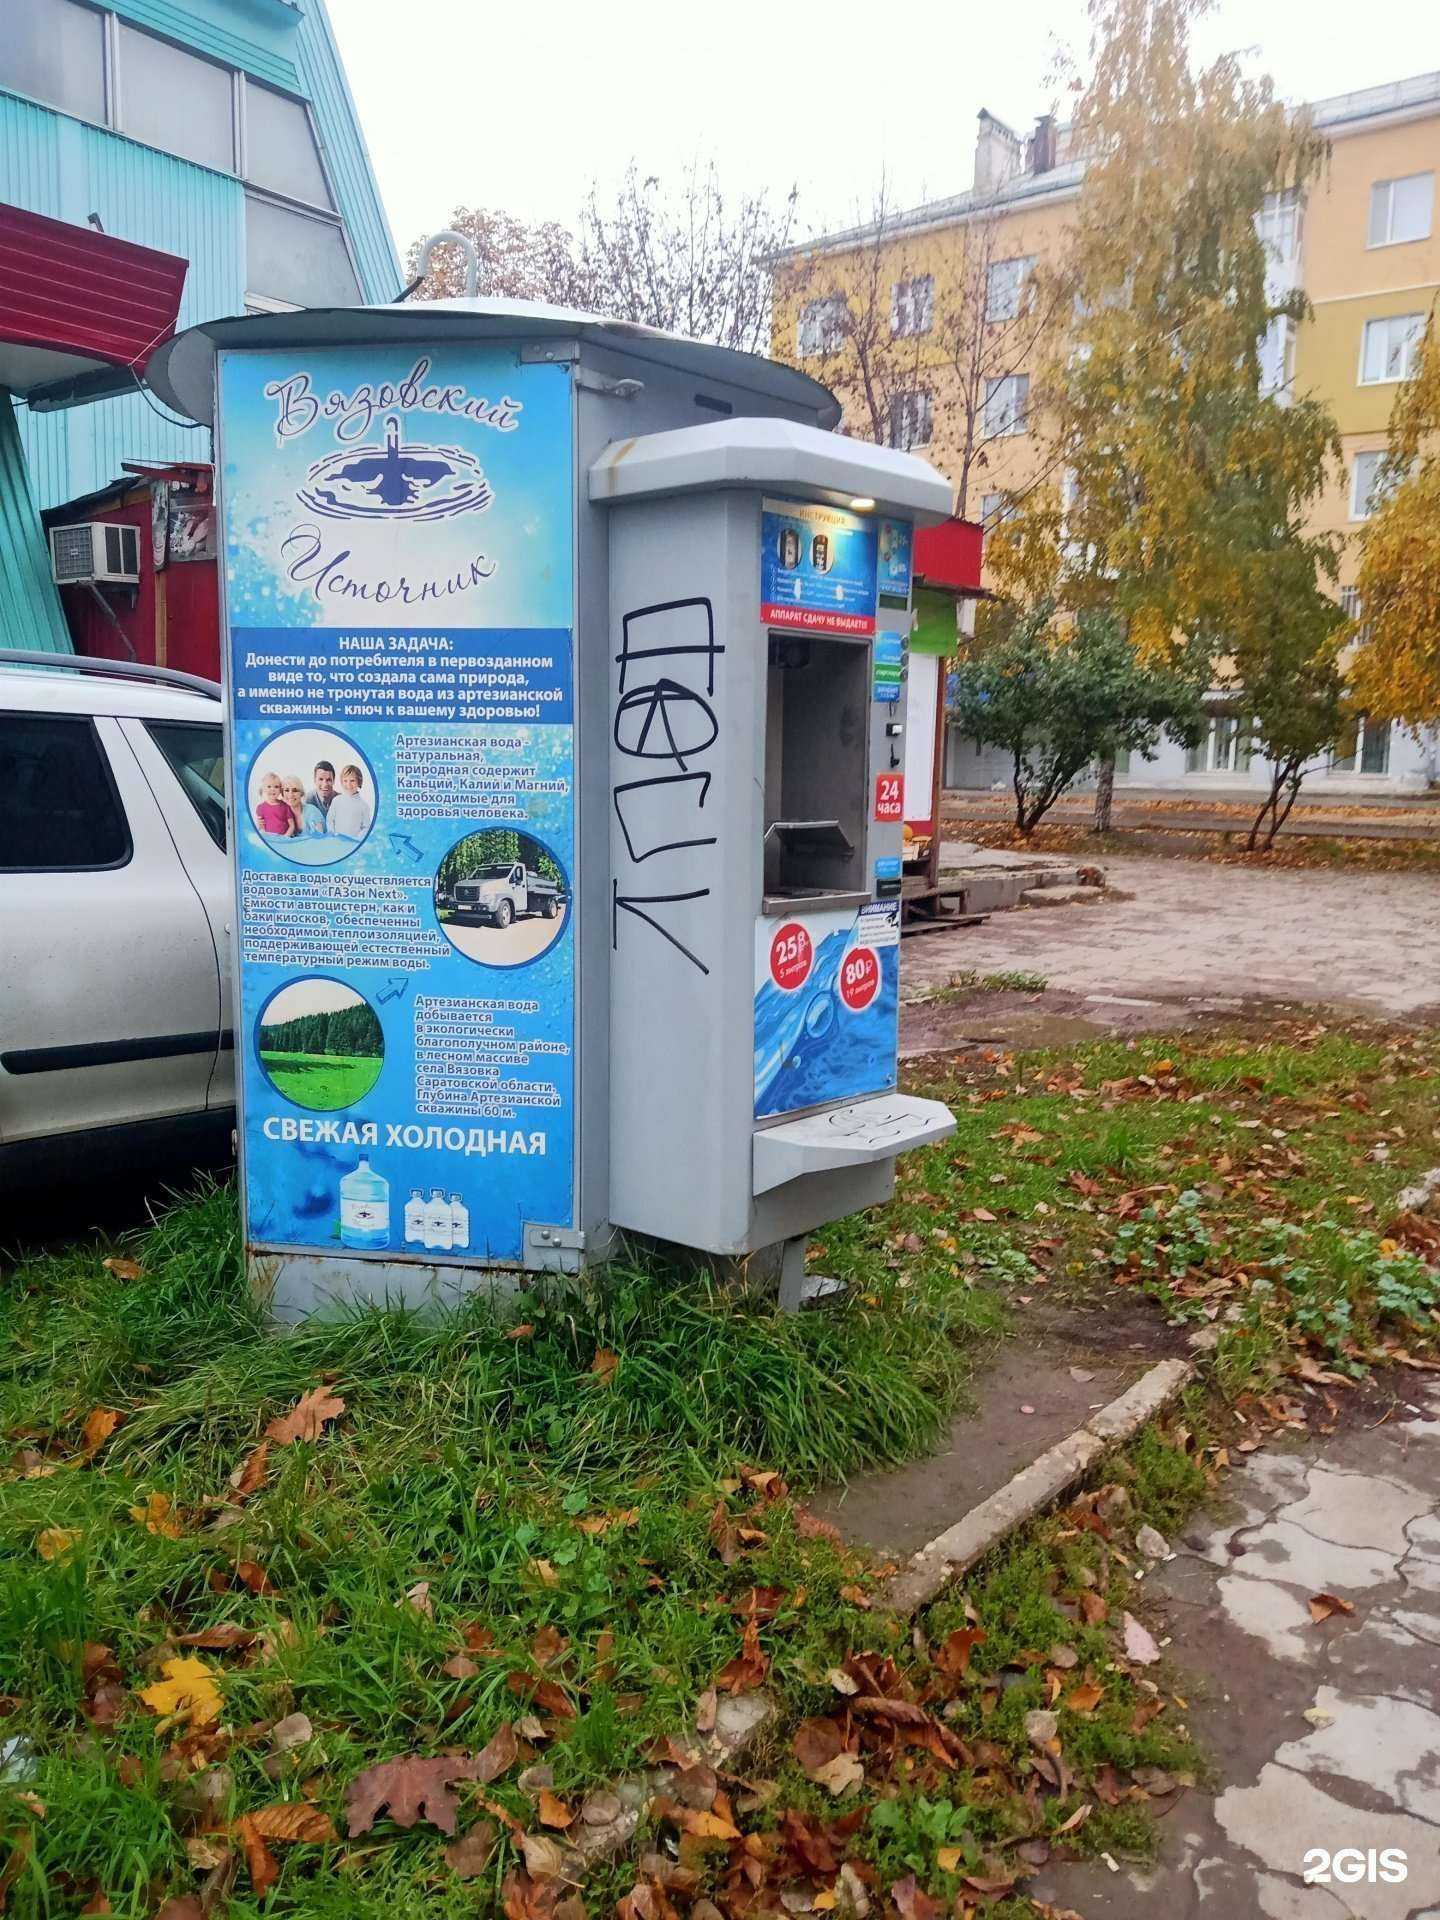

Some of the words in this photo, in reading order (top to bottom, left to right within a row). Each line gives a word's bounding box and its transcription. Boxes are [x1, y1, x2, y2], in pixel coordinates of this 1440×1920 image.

[267, 359, 519, 441] Вязовский
[280, 524, 496, 603] Источник
[770, 609, 802, 622] АППАРАТ
[803, 613, 825, 625] СДАЧУ
[826, 616, 836, 626] НЕ
[339, 637, 384, 650] НАША
[388, 637, 453, 652] ЗАДАЧА:
[246, 652, 305, 668] Донести
[309, 655, 327, 669] до
[330, 653, 425, 669] потребителя
[429, 657, 436, 667] в
[440, 657, 553, 670] первозданном
[269, 672, 303, 684] виде
[307, 672, 326, 684] то,
[330, 672, 354, 683] что
[358, 673, 416, 685] создала
[420, 673, 455, 683] сама
[459, 673, 530, 687] природа,
[237, 688, 245, 698] а
[250, 688, 304, 698] именно
[307, 688, 324, 698] не
[327, 688, 394, 702] тронутая
[398, 690, 433, 702] вода
[437, 690, 454, 700] из
[457, 688, 563, 702] артезианской
[259, 703, 333, 714] скважины
[345, 705, 382, 715] ключ
[386, 706, 394, 715] к
[398, 706, 455, 719] вашему
[459, 704, 540, 719] здоровью!
[396, 735, 487, 749] Артезианская
[490, 737, 522, 749] вода
[396, 751, 484, 763] натуральная,
[397, 765, 469, 777] природная
[472, 766, 536, 777] содержит
[397, 777, 457, 791] Кальций,
[460, 778, 500, 790] Калий
[503, 780, 511, 790] и
[514, 778, 569, 793] Магний,
[881, 780, 899, 800] 24
[398, 792, 487, 804] необходимые
[491, 795, 515, 806] для
[398, 806, 460, 818] здоровья
[463, 808, 528, 819] человека.
[877, 802, 901, 815] часа
[242, 870, 297, 883] Доставка
[300, 873, 331, 884] воды
[334, 876, 431, 887] осуществляется
[243, 885, 319, 897] водовозами
[322, 887, 366, 898] «ГАЗон
[297, 901, 380, 913] автоцистерн,
[383, 904, 405, 913] как
[407, 904, 415, 913] и
[276, 913, 330, 925] киосков,
[335, 913, 420, 927] обеспеченны
[244, 924, 329, 937] необходимой
[332, 928, 441, 942] теплоизоляцией,
[245, 939, 358, 952] поддерживающей
[362, 943, 450, 956] естественный
[245, 952, 343, 966] температурный
[347, 956, 389, 967] режим
[392, 958, 430, 969] воды.
[416, 995, 504, 1009] Артезианская
[508, 1000, 538, 1011] вода
[416, 1010, 492, 1022] добывается
[416, 1025, 423, 1033] в
[426, 1024, 514, 1036] экологически
[416, 1036, 515, 1049] благополучном
[519, 1040, 569, 1054] районе,
[416, 1051, 423, 1059] в
[426, 1051, 472, 1062] лесном
[476, 1054, 528, 1064] массиве
[416, 1065, 443, 1074] села
[447, 1064, 499, 1076] Вязовка
[417, 1076, 497, 1089] Саратовской
[417, 1089, 467, 1102] Глубина
[470, 1092, 560, 1106] Артезианской
[417, 1104, 481, 1116] скважины
[484, 1105, 499, 1116] 60
[502, 1108, 516, 1118] м.
[263, 1117, 377, 1146] СВЕЖАЯ
[386, 1124, 546, 1157] ХОЛОДНАЯ
